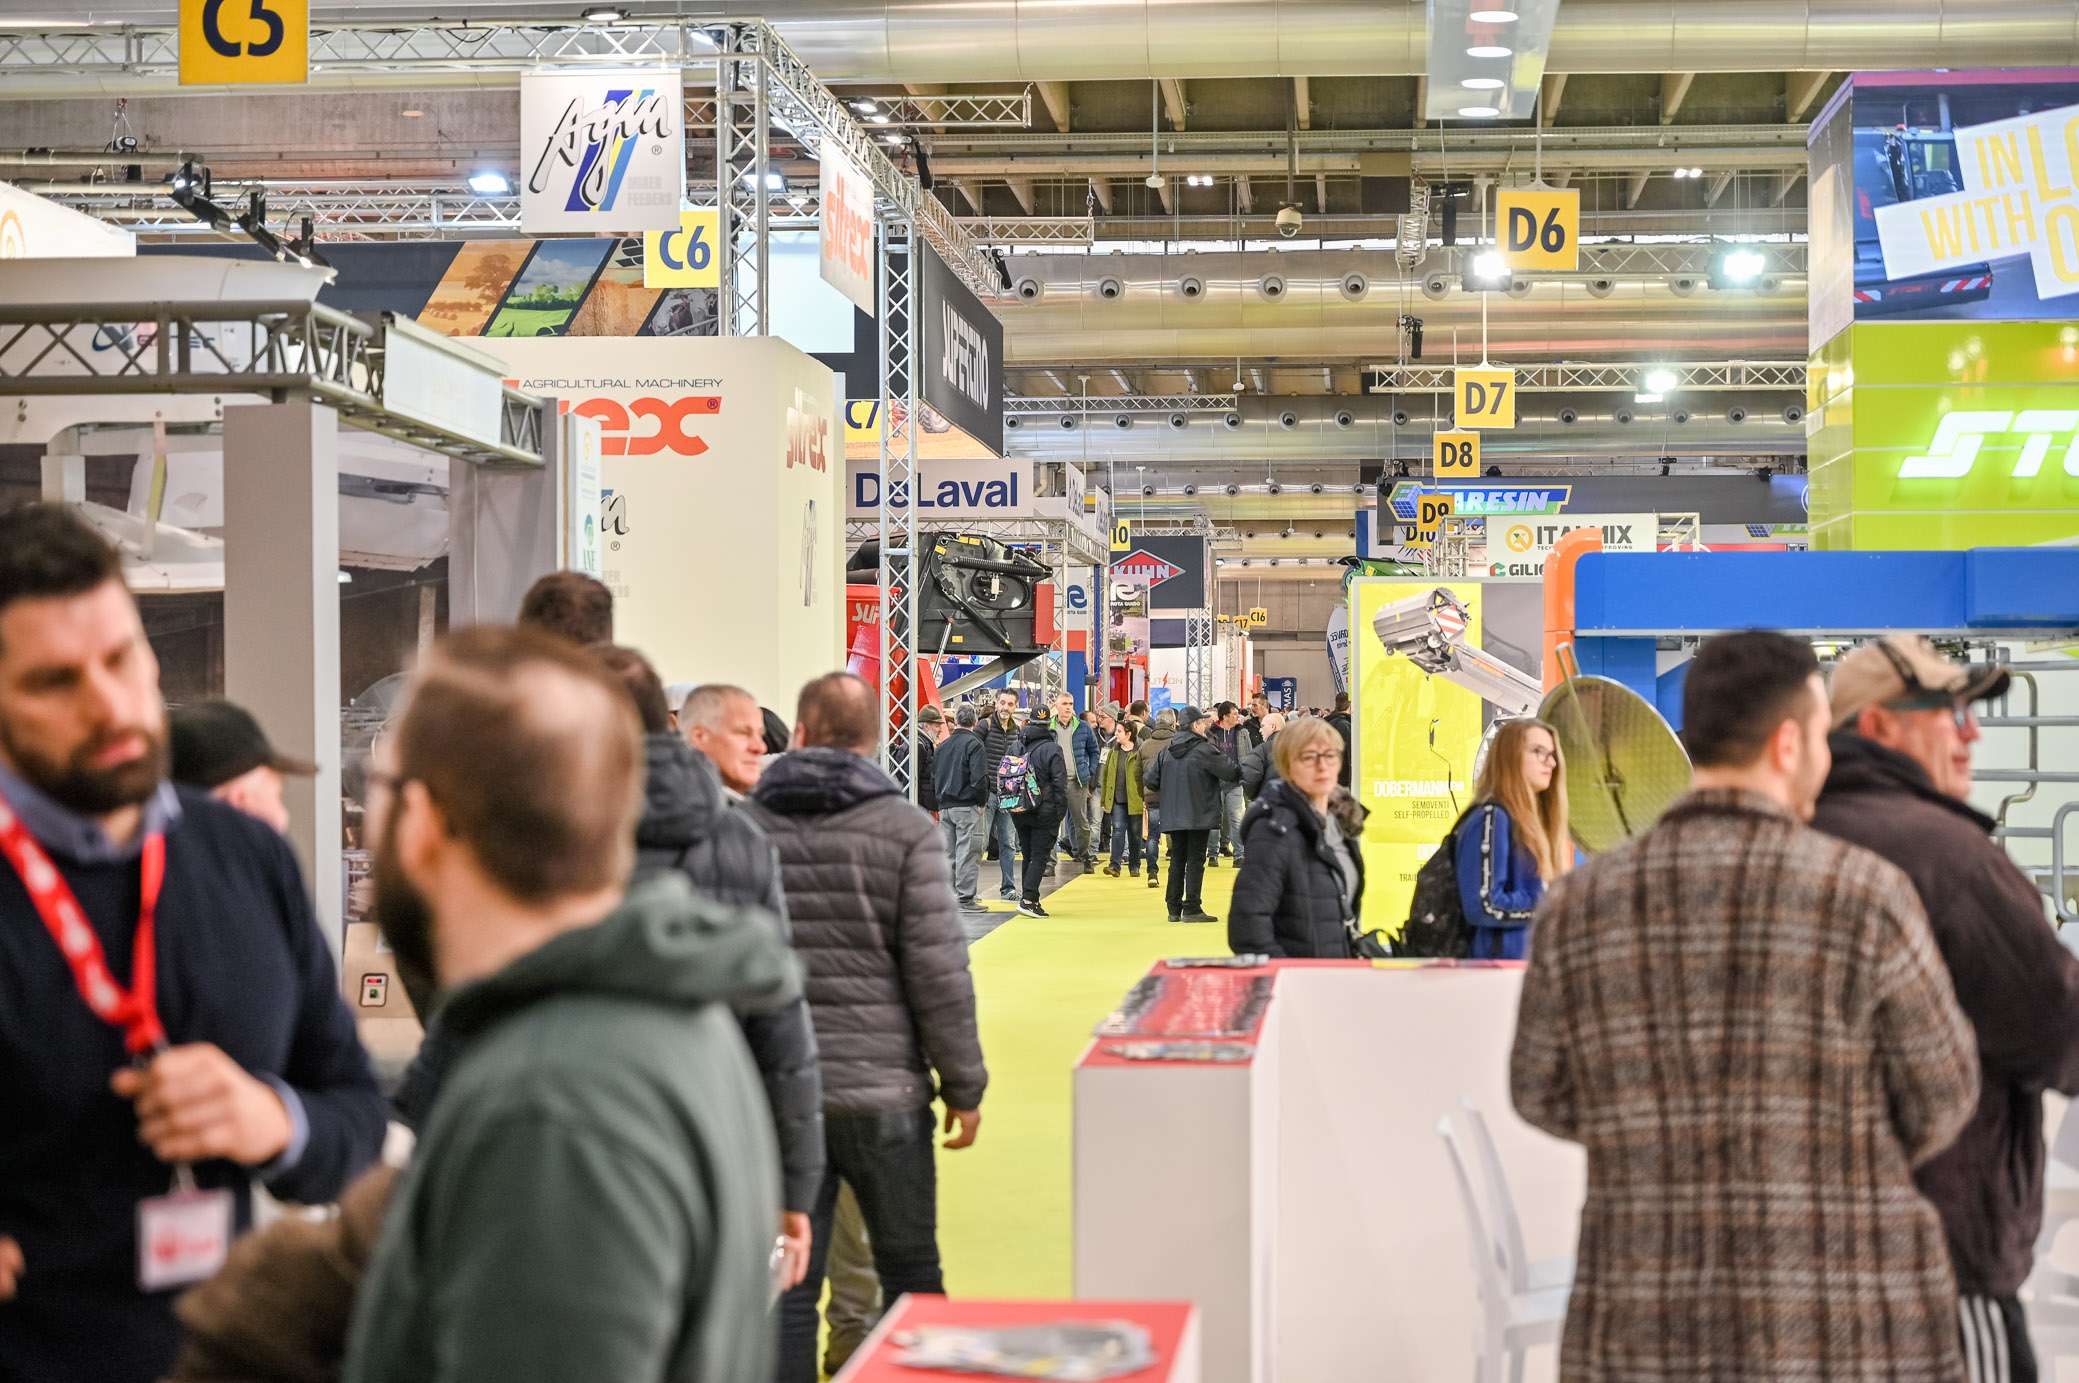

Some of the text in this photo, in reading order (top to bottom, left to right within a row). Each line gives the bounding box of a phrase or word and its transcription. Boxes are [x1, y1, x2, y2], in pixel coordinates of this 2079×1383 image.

[202, 0, 284, 57] C5
[1974, 131, 2024, 190] IN
[1508, 207, 1565, 253] D6
[1920, 190, 2037, 260] WITH
[659, 226, 711, 270] C6
[522, 378, 724, 389] AGRICULTURAL MACHINERY
[1465, 382, 1507, 415] D7
[845, 400, 880, 430] C7
[1440, 442, 1473, 467] D8
[855, 472, 1018, 508] DeLaval
[1440, 491, 1551, 513] ARESIN
[1113, 565, 1170, 579] KUHN
[1250, 611, 1266, 622] C16
[1393, 810, 1450, 819] SELF-PROPELLED
